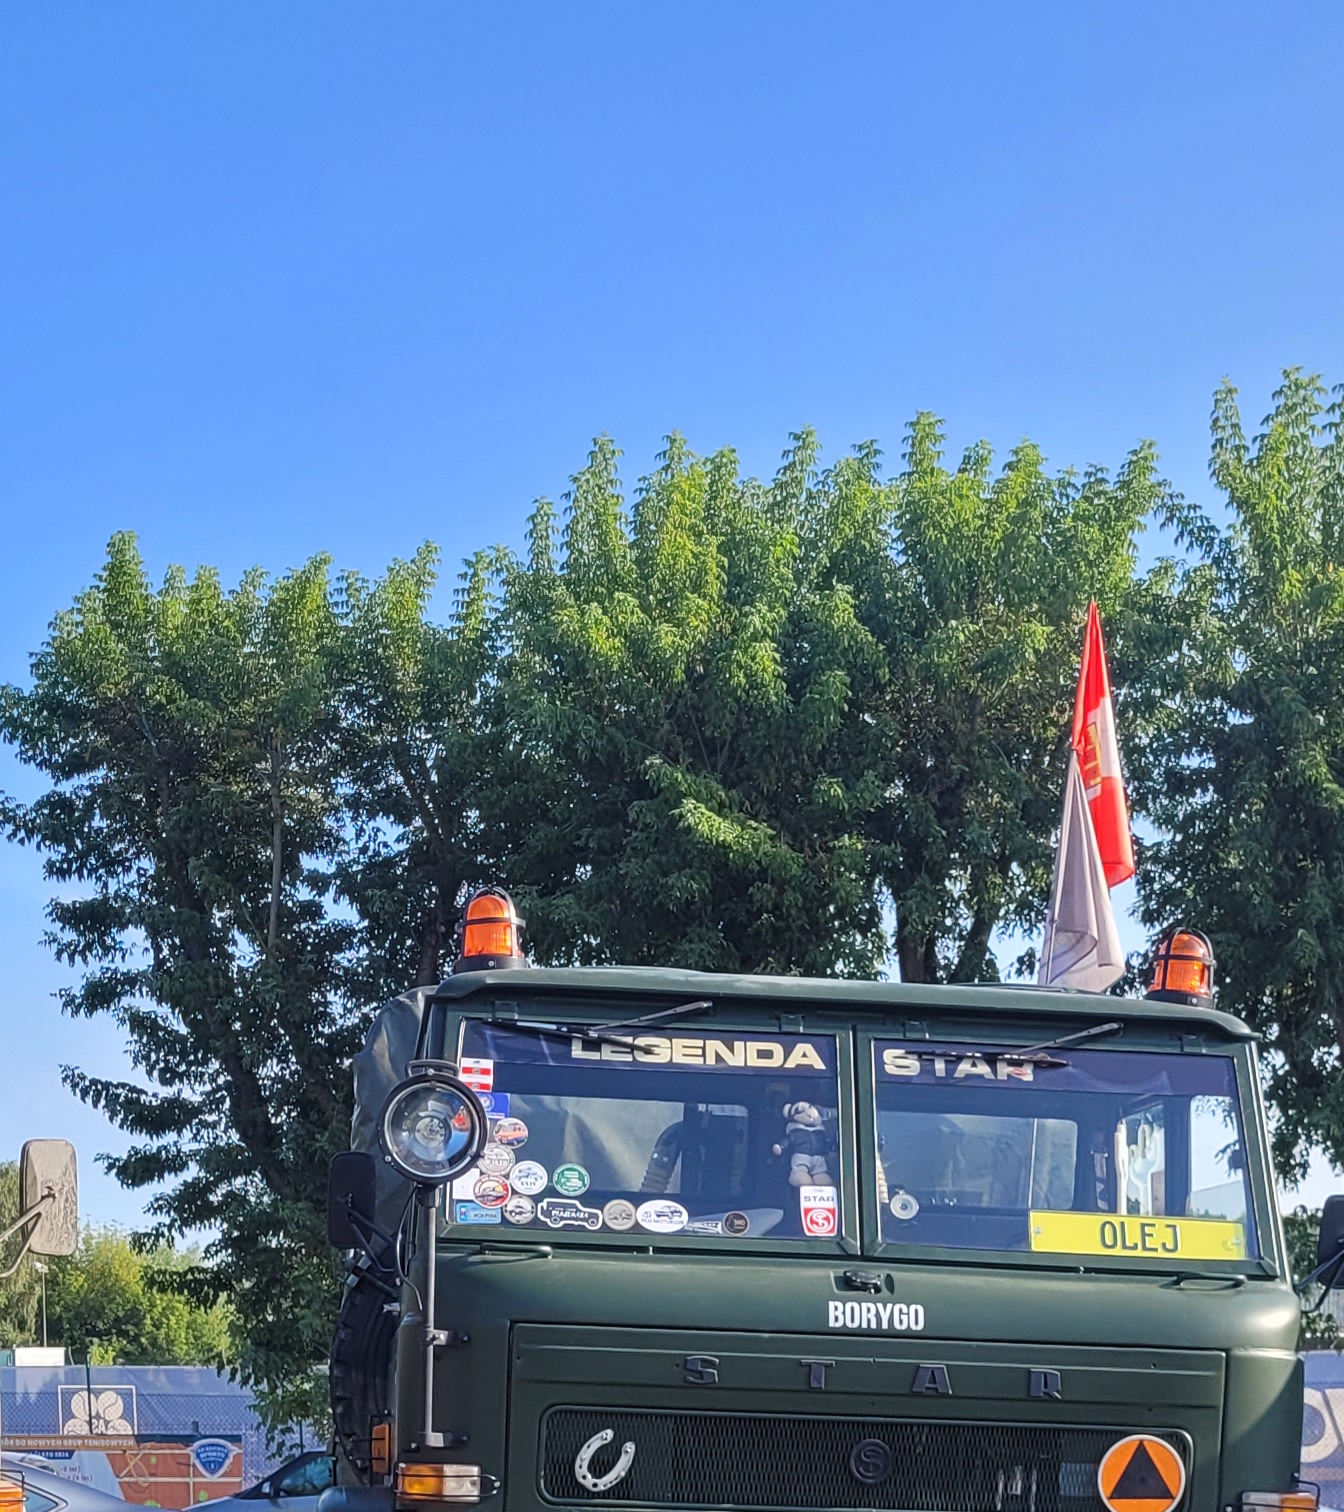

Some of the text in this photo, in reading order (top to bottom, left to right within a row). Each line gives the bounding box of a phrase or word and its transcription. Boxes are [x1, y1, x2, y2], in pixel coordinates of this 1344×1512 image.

[571, 1035, 827, 1070] LEGENDA
[1099, 1221, 1180, 1253] OLEJ
[828, 1300, 925, 1331] BORYGO
[685, 1355, 1062, 1399] STAR
